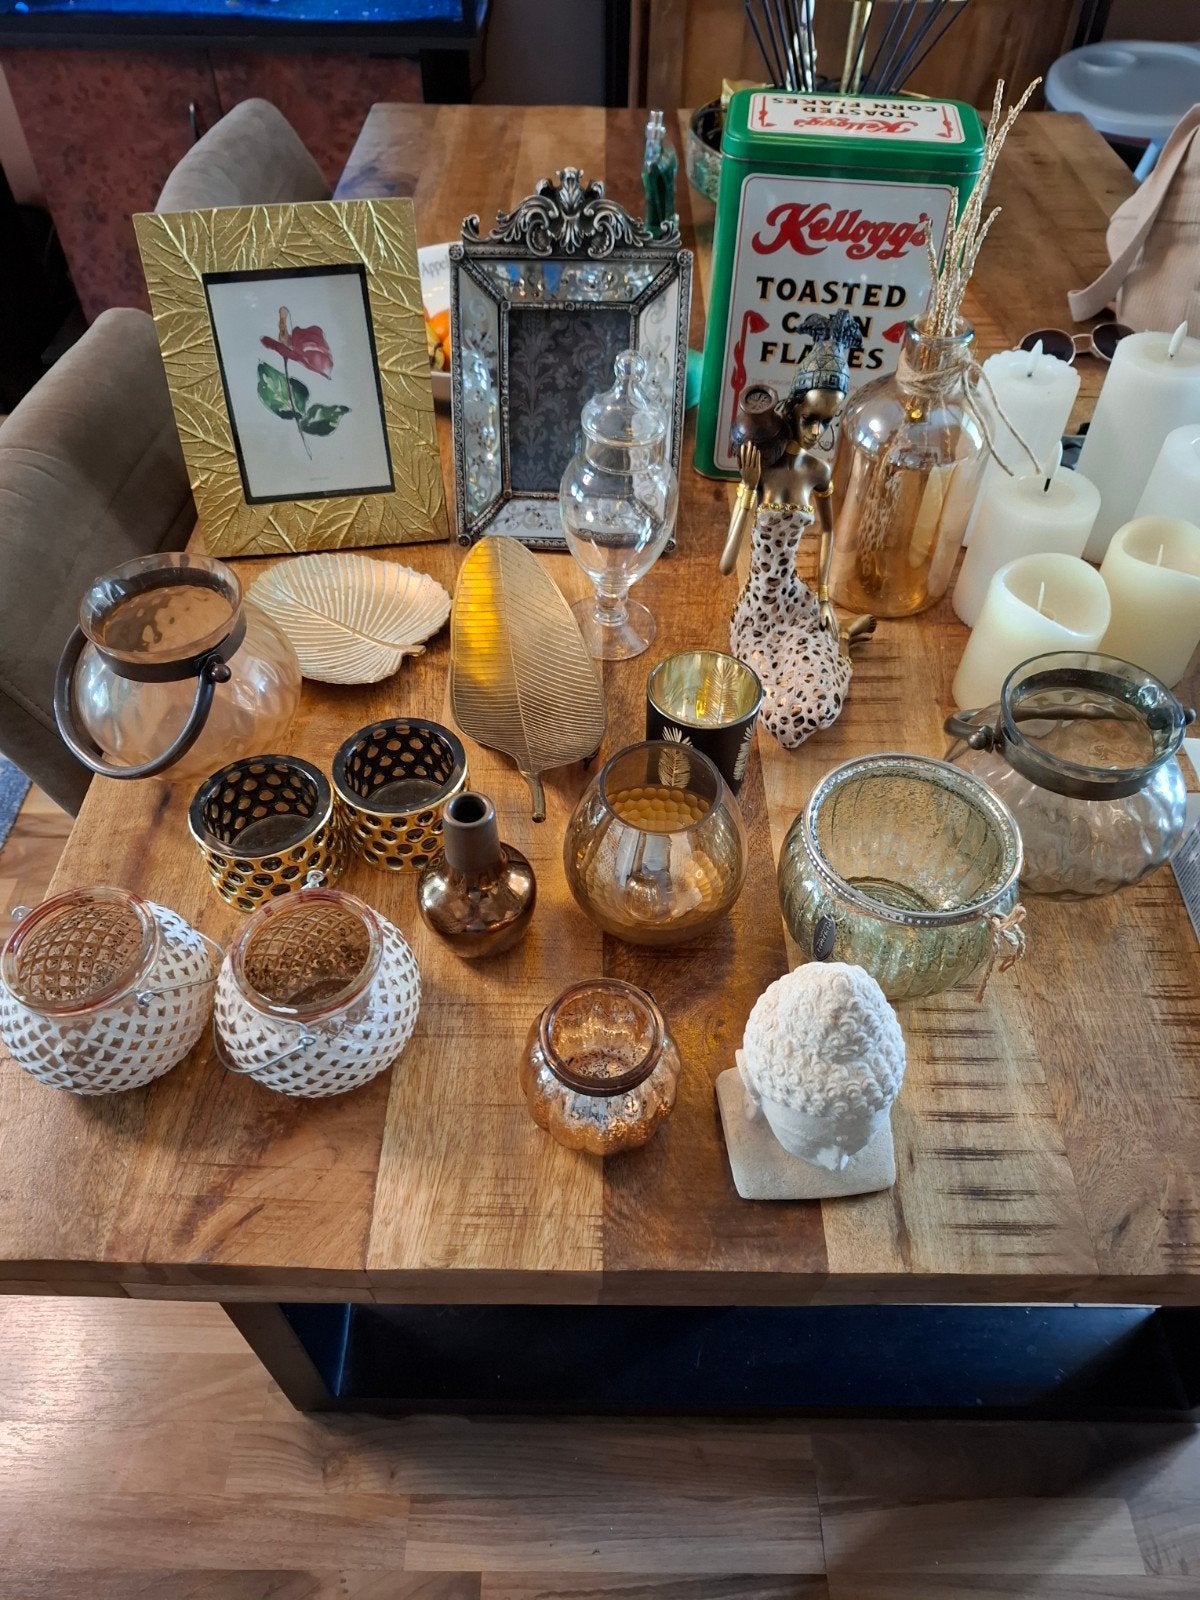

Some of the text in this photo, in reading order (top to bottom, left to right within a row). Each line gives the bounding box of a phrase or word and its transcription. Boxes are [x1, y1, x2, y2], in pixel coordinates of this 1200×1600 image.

[772, 97, 938, 113] CORN FLAKES
[802, 106, 909, 119] TOASTED
[794, 117, 918, 133] Kellogg's
[751, 203, 930, 261] Kellogg's
[756, 276, 907, 308] TOASTED
[781, 311, 873, 338] CN
